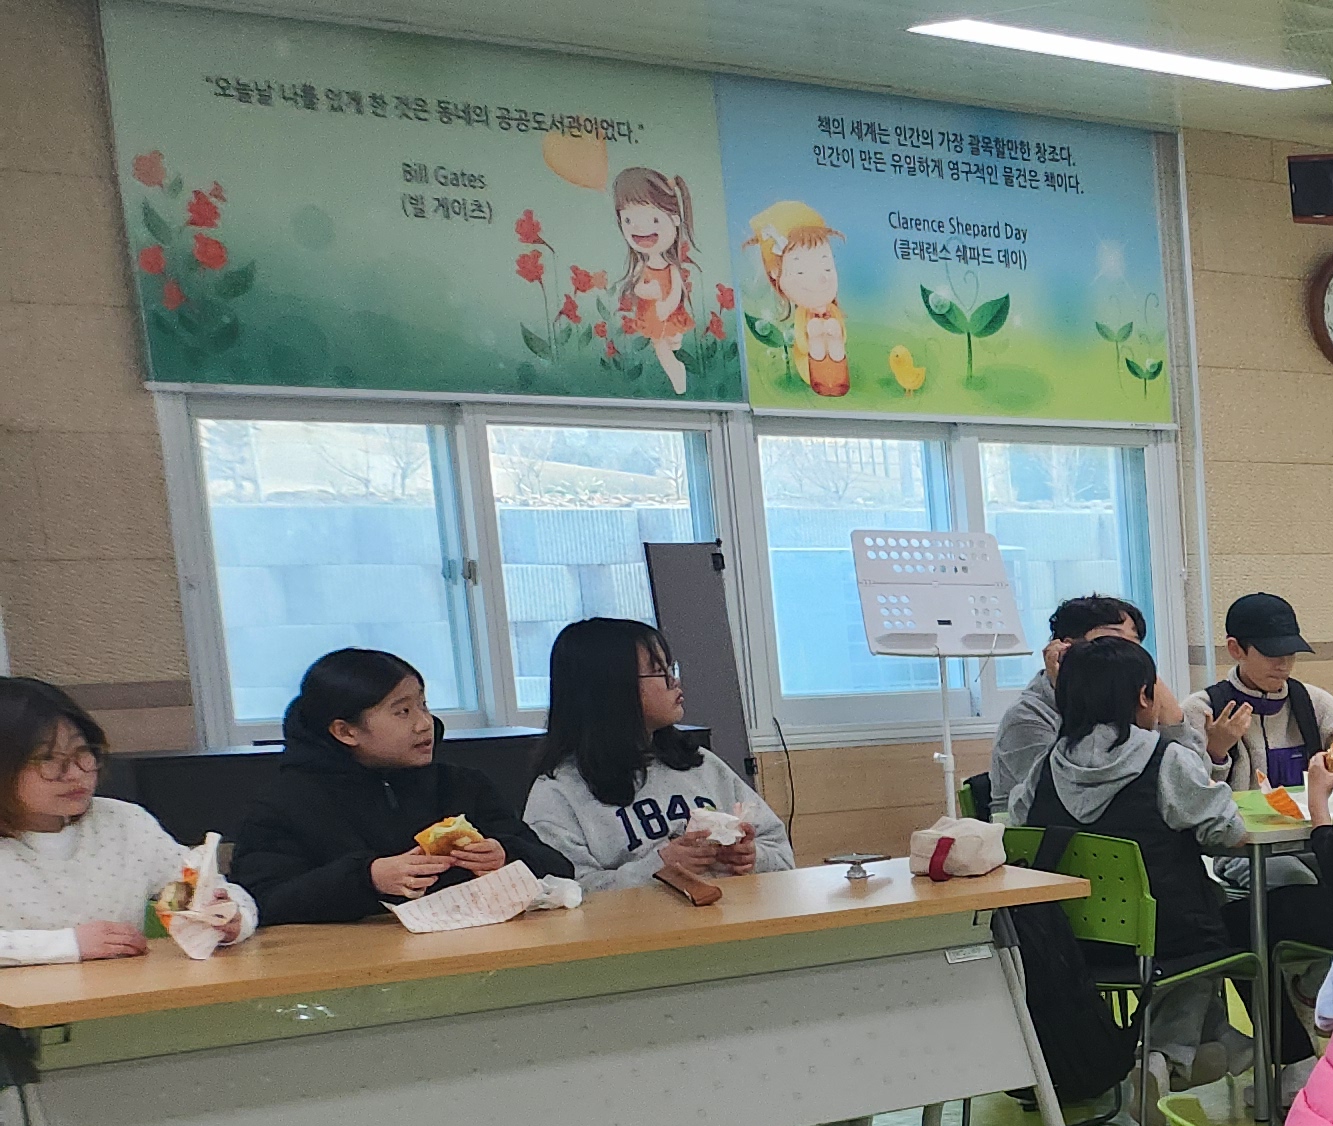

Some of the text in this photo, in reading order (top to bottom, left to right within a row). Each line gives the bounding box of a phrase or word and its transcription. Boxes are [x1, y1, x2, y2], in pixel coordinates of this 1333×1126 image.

[436, 99, 490, 125] 동네의
[817, 115, 1077, 167] 책의 세계는 인간의 가장 괄목할만한 창조다.
[402, 162, 487, 190] Bill Gates
[813, 144, 1085, 195] 인간이 만든 유일하게 영구적인 물건은 책이다.
[433, 197, 493, 224] 게이츠)
[888, 210, 1028, 244] Clarence Shepard Day
[955, 244, 995, 267] 쉐파드
[997, 249, 1028, 271] 데이)
